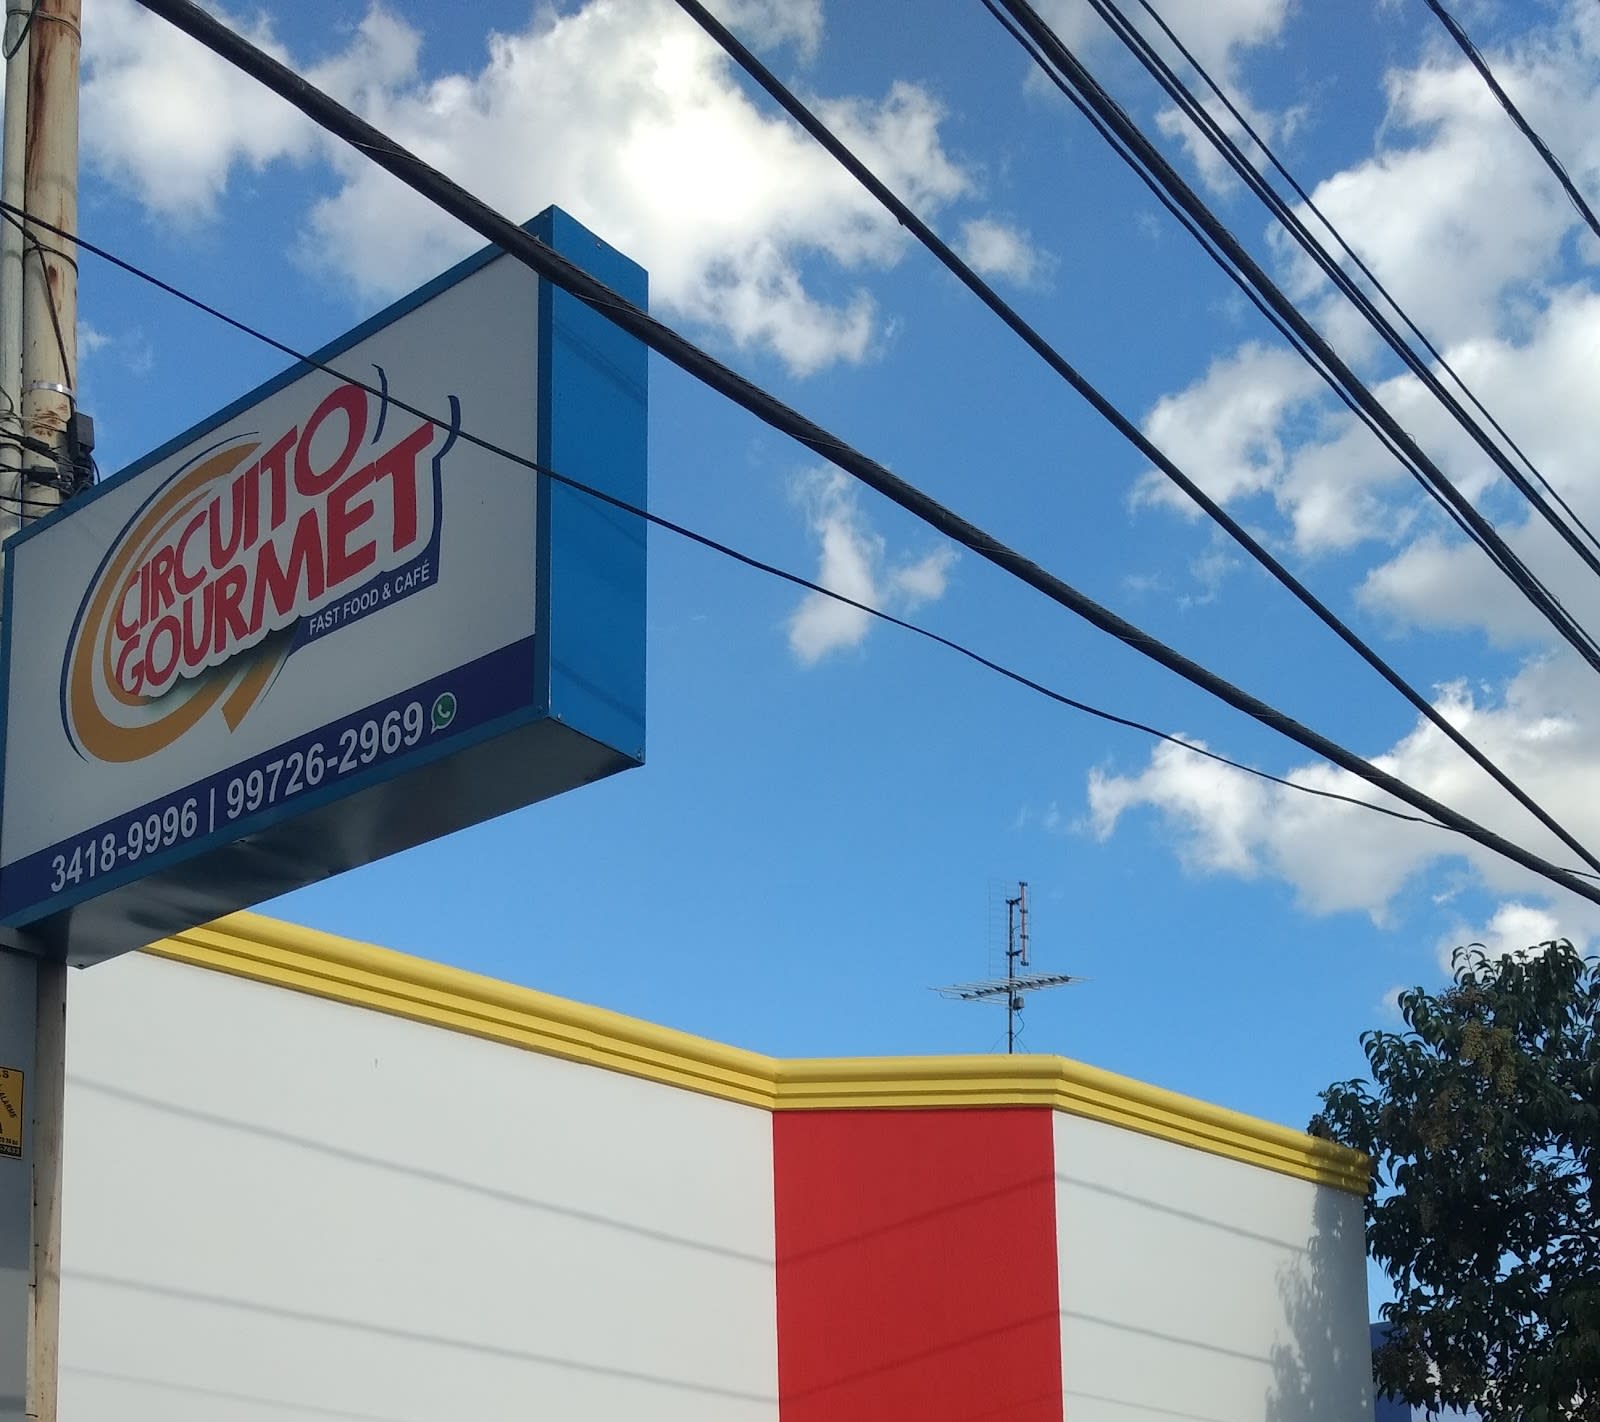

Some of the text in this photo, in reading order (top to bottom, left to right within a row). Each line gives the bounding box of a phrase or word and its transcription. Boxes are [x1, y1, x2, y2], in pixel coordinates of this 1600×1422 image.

[116, 421, 434, 696] GOURMET
[117, 384, 368, 641] CIRCUITO
[309, 559, 430, 636] FAST FOOD & CAFÉ
[51, 798, 198, 894] 3418-9996
[226, 701, 424, 819] 99726-2969
